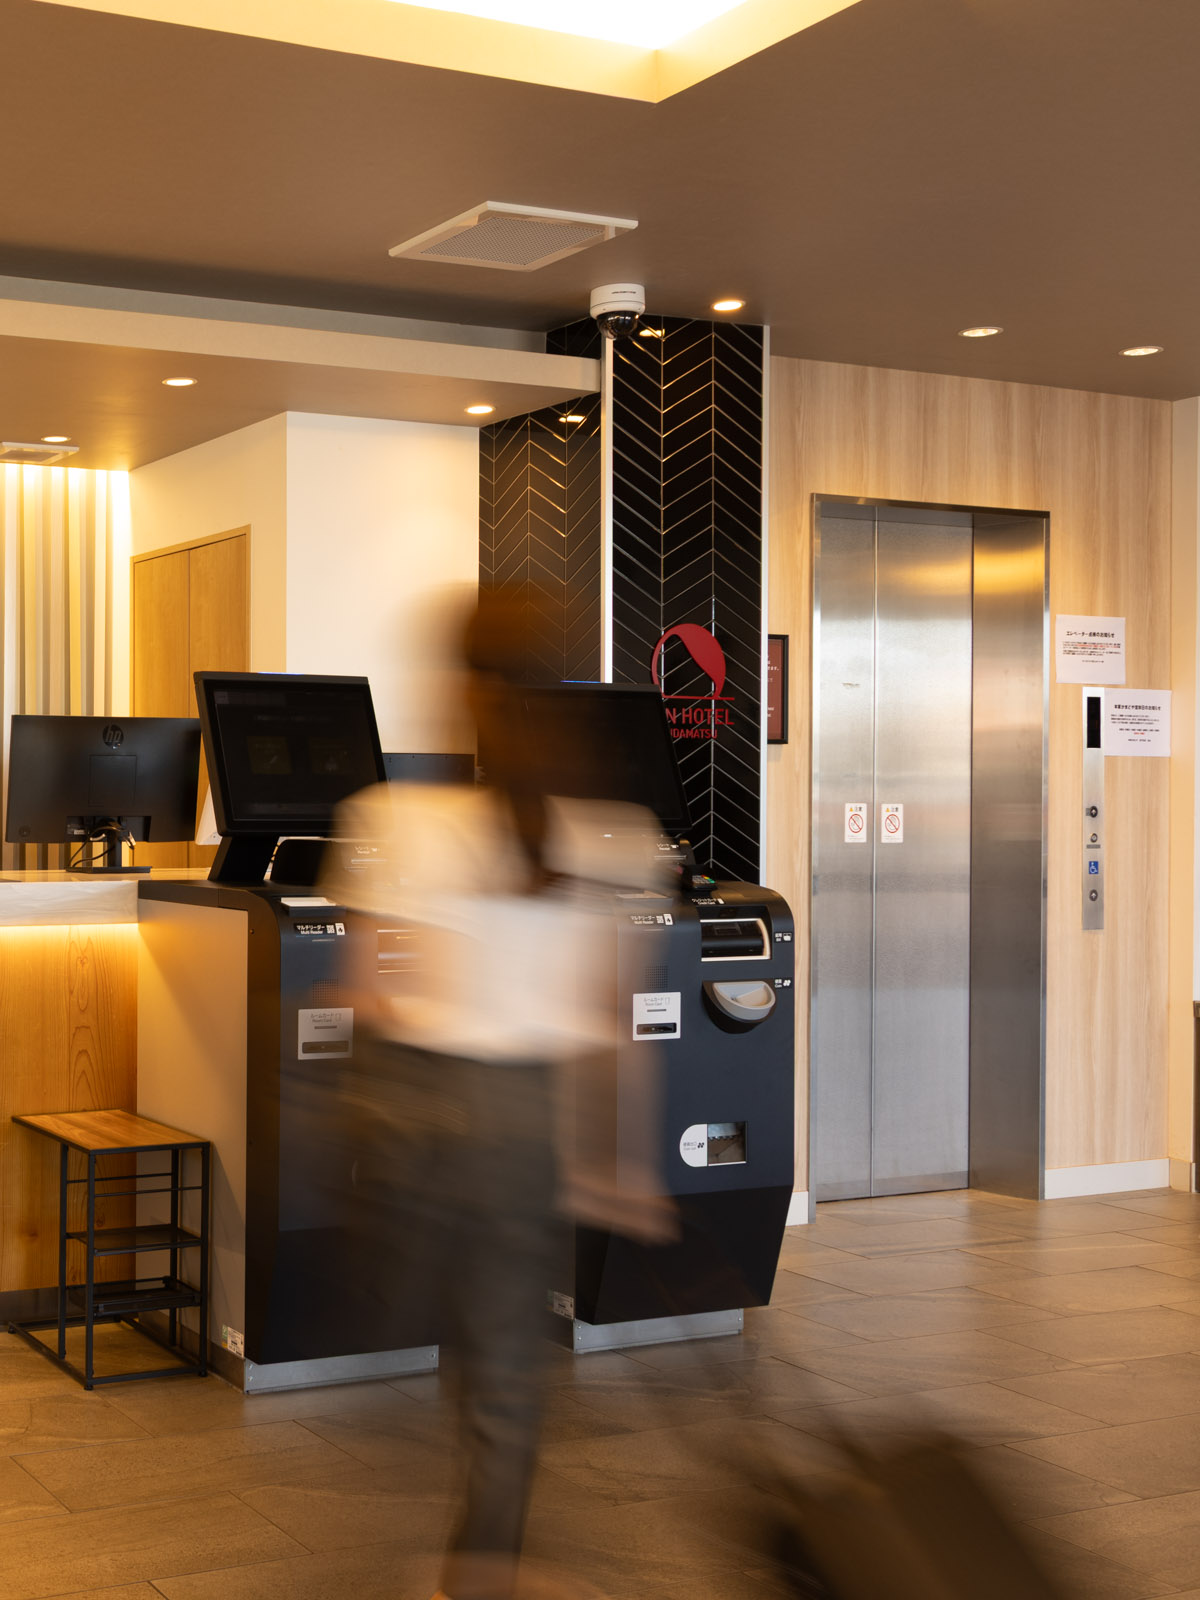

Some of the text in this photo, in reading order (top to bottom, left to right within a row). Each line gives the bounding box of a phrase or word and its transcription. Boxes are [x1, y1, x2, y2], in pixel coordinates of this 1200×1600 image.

[681, 707, 735, 725] HOTEL
[103, 725, 123, 748] hp
[670, 728, 718, 739] DAMATSU
